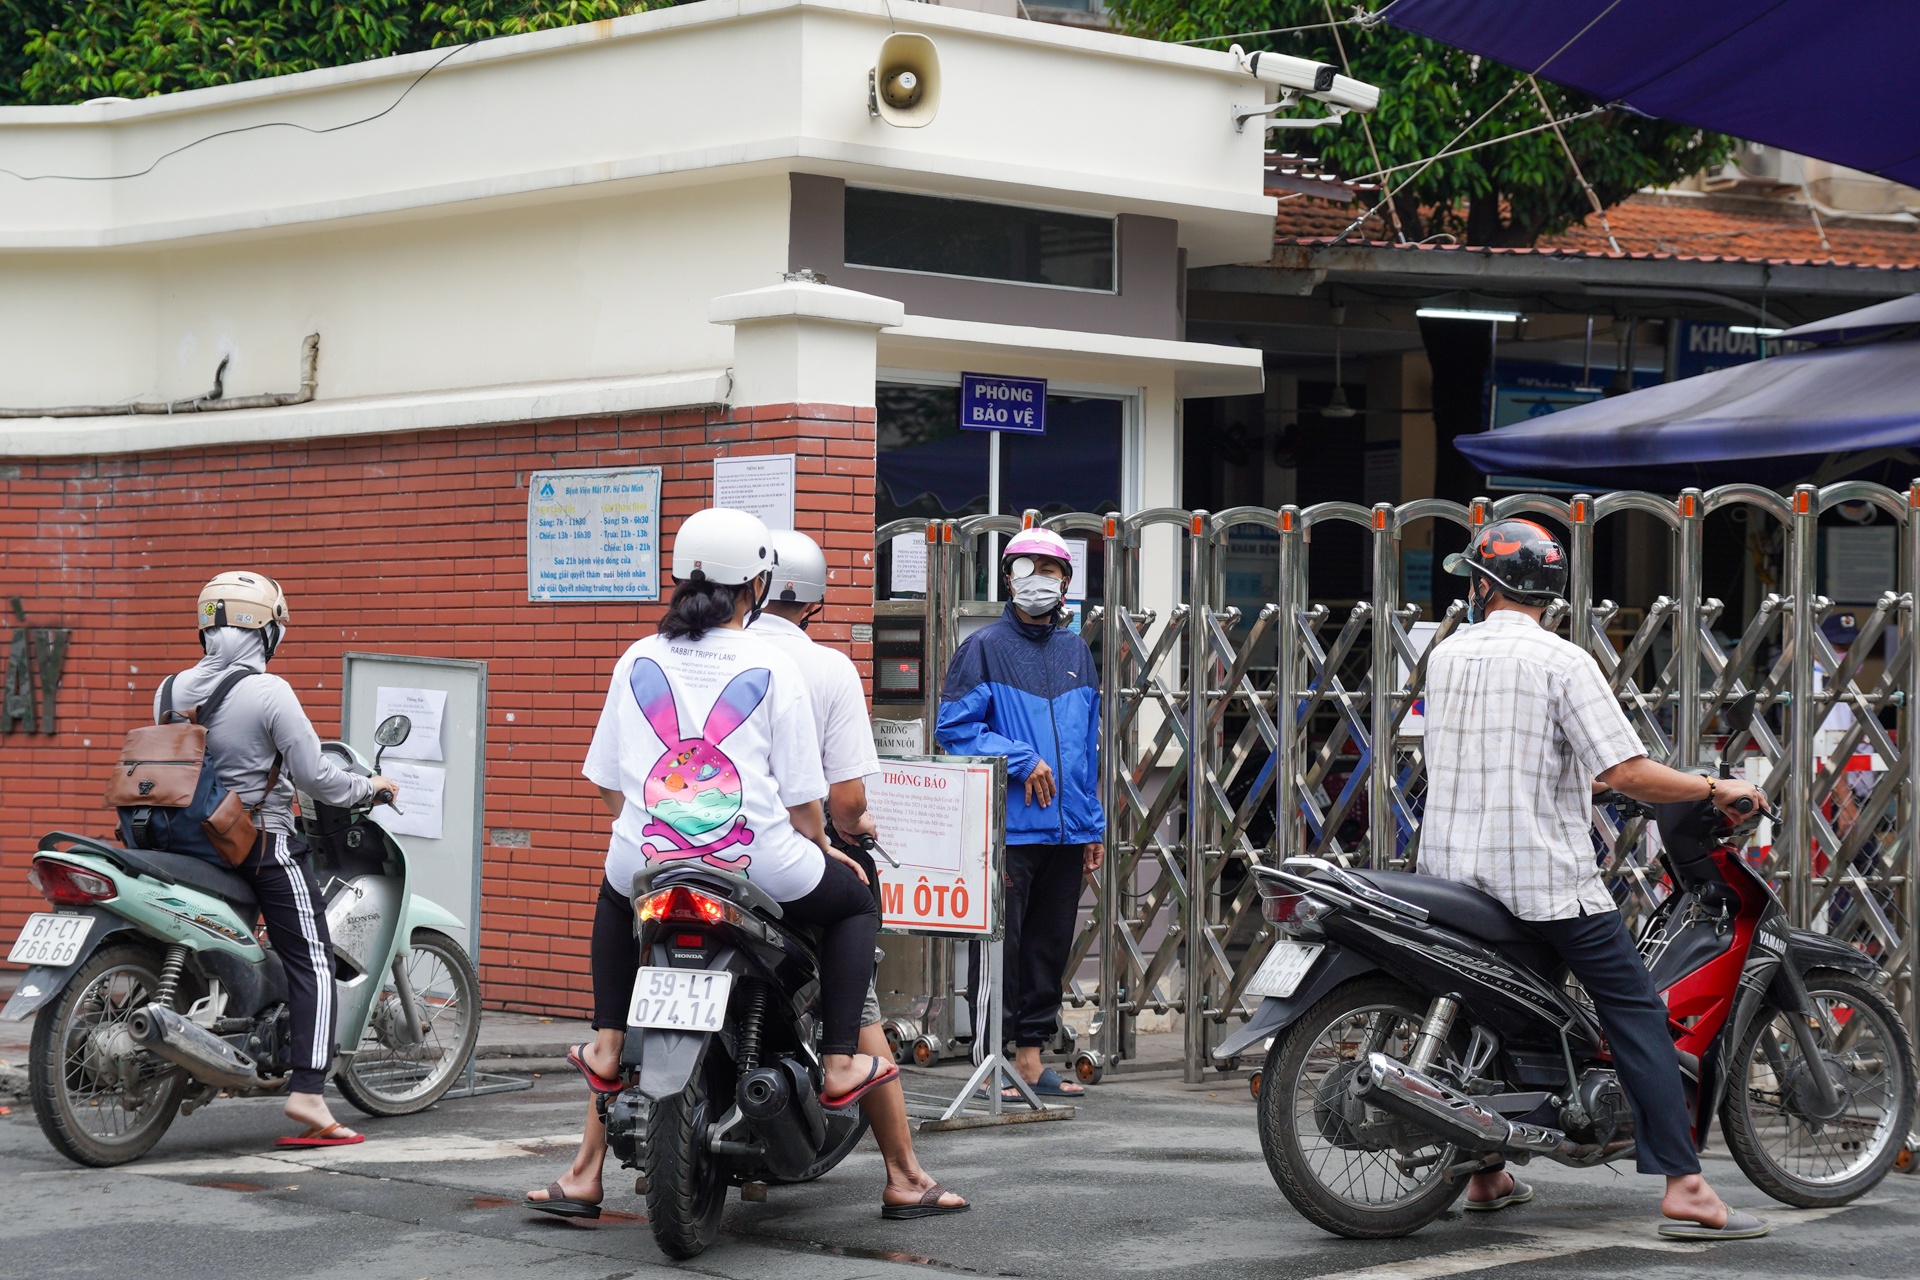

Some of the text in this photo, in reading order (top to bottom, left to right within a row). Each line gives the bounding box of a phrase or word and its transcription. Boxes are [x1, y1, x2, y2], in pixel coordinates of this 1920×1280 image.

[1689, 325, 1757, 355] KHOA
[975, 383, 1033, 403] PHÒNG
[973, 403, 1034, 427] BẢO VỆ
[580, 487, 590, 495] Viện
[592, 486, 601, 494] Mắt
[603, 486, 611, 494] TP.
[631, 484, 643, 492] Minh
[539, 518, 555, 527] Sáng:
[569, 518, 586, 526] 11h30
[604, 516, 649, 526] Sáng: 5h 6h30
[574, 531, 591, 539] 16h30
[621, 530, 631, 538] 11h
[640, 543, 650, 551] 21h
[566, 557, 576, 565] 21h
[578, 557, 591, 565] bệnh
[617, 570, 630, 579] bệnh
[671, 646, 736, 661] RABBIT TRIPPY LAND
[881, 723, 907, 735] KHÔNG
[883, 771, 947, 789] THÔNG BÁO
[914, 876, 969, 918] ÔTÔ
[347, 912, 380, 924] HONDA
[33, 918, 81, 940] 61-C1
[14, 940, 76, 961] 766.66
[1760, 930, 1788, 956] YAMAH
[649, 973, 713, 1000] 59-L1
[635, 998, 716, 1027] 074.14
